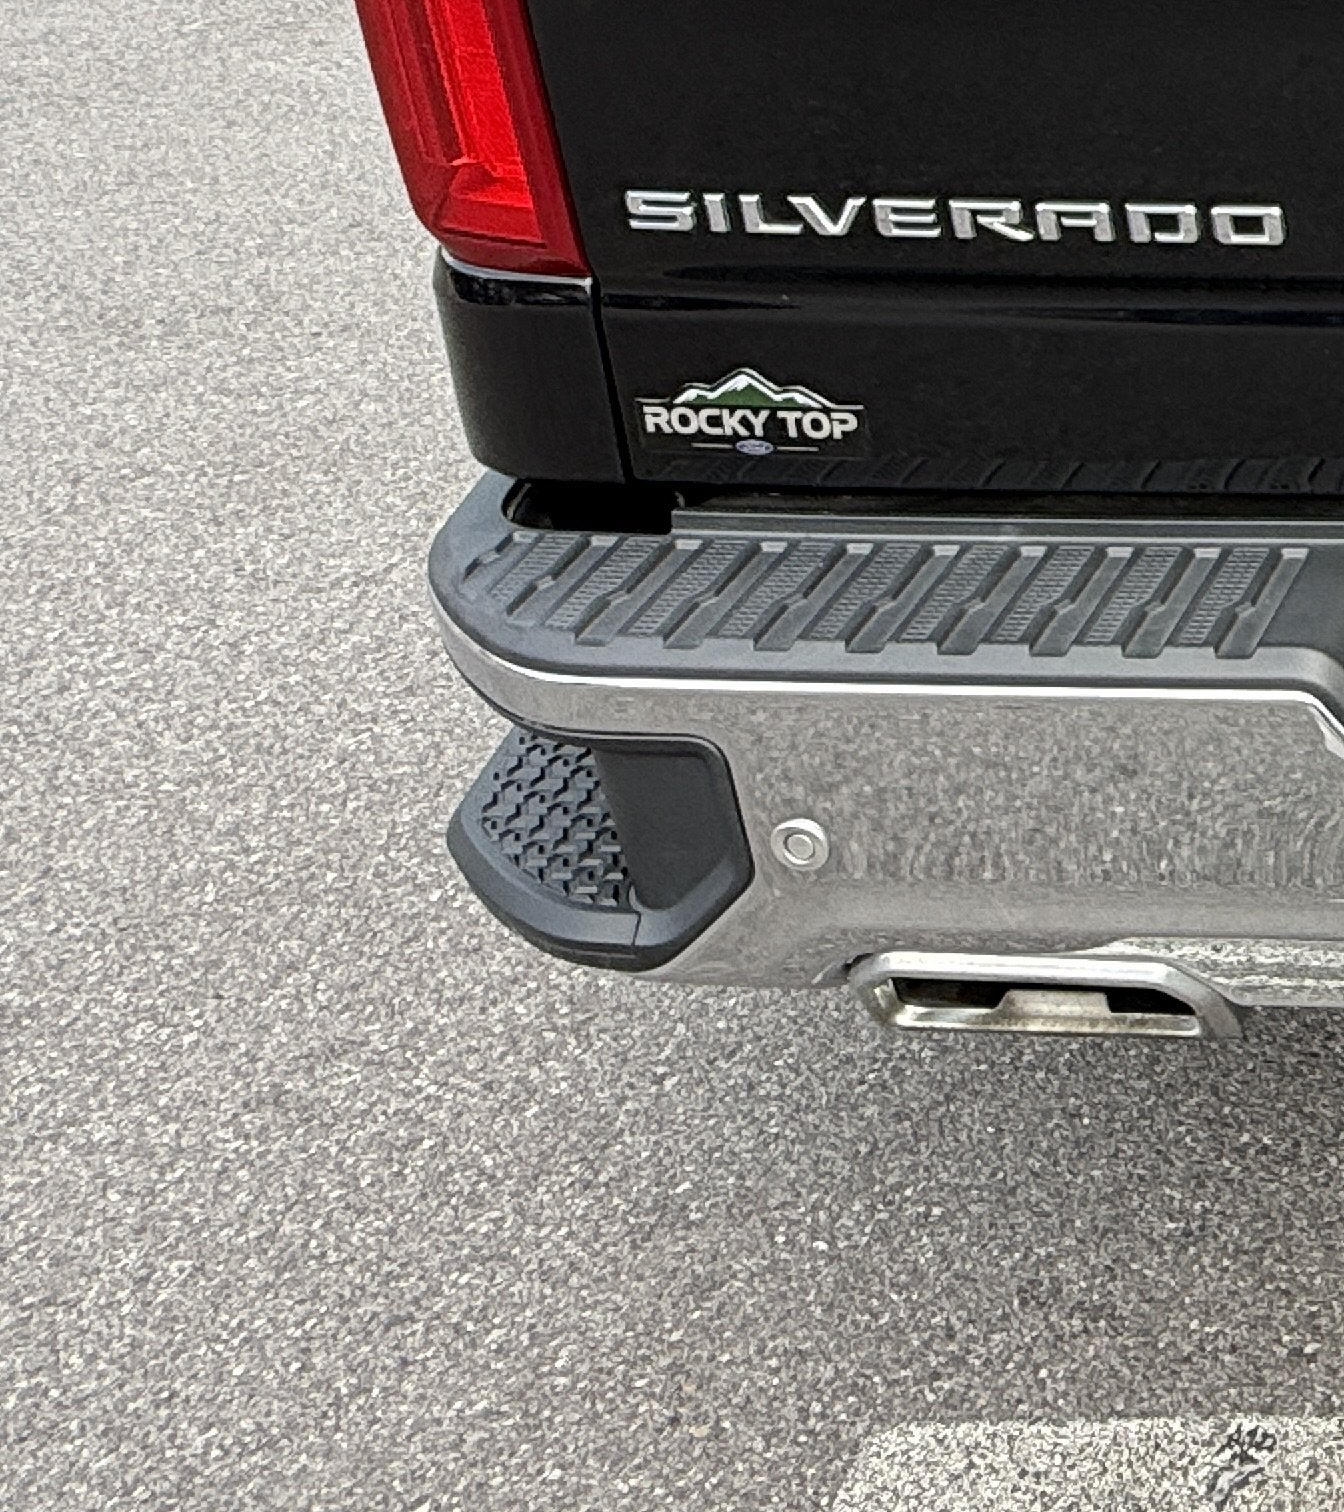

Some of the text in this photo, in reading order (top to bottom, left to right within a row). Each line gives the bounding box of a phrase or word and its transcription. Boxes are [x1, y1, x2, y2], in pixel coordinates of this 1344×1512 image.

[623, 189, 1286, 247] SILVERADO
[642, 404, 859, 440] ROCKY TOP
